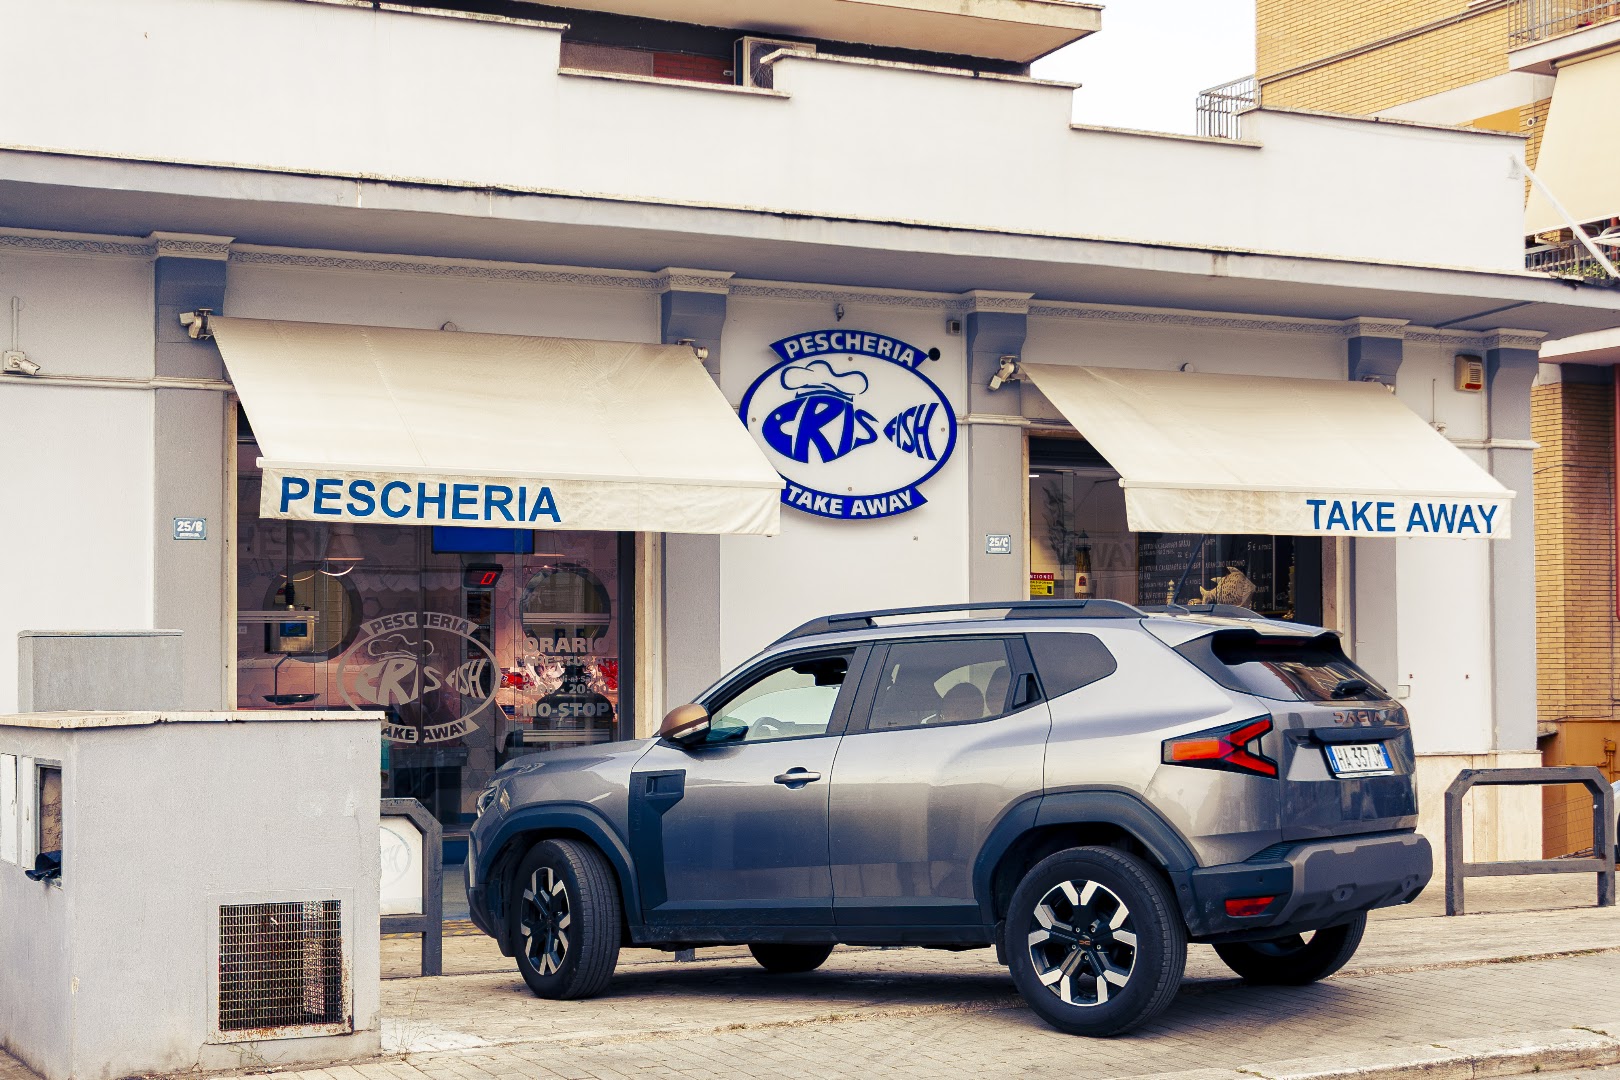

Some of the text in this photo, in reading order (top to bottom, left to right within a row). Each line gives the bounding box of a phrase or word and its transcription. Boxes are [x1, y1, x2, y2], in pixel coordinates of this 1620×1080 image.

[783, 332, 916, 367] PESCHERIA
[762, 395, 940, 464] CRIS FISH
[279, 476, 562, 523] PESCHERIA
[787, 485, 913, 516] TAKE AWAY
[1306, 499, 1498, 534] TAKE AWAY
[988, 537, 1009, 547] 25/C
[369, 613, 470, 635] PESCERIA
[523, 637, 610, 653] ORARIO
[445, 658, 488, 700] FISH
[523, 702, 610, 717] NO-STOP
[1333, 710, 1381, 724] DACIA
[381, 721, 468, 741] AKE AWAY
